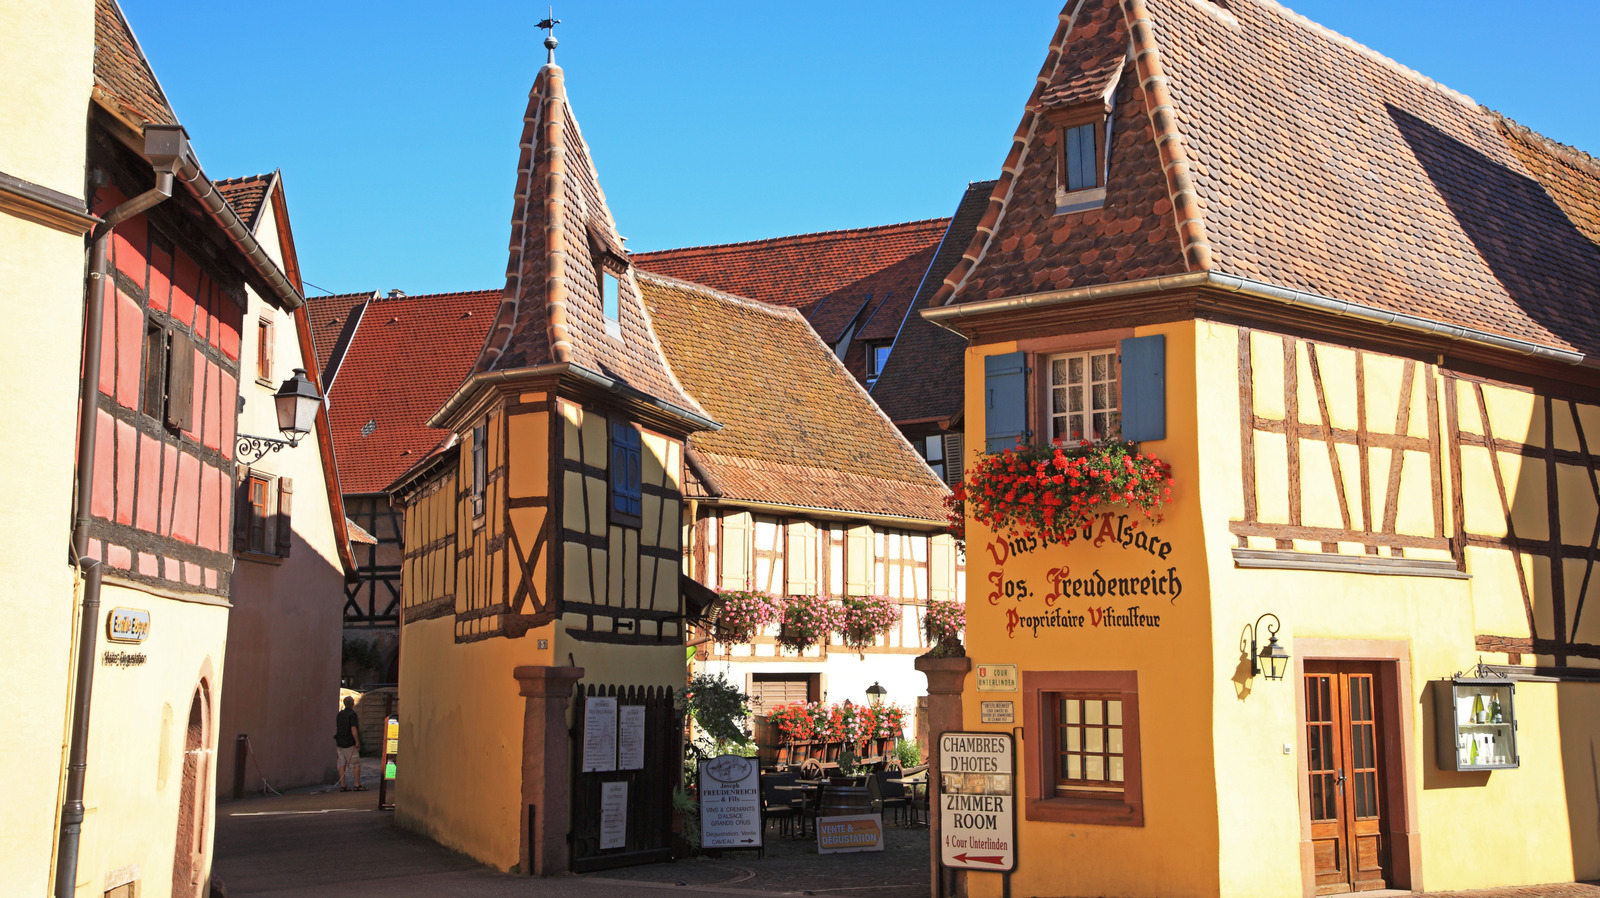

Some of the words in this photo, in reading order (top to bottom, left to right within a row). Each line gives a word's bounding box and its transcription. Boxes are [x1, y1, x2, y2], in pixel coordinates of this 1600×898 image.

[986, 533, 1037, 567] Vins
[1081, 512, 1172, 560] d'Alsace
[988, 568, 1034, 606] Jos.
[1045, 565, 1183, 606] Freudenreich
[1006, 607, 1085, 639] Propriétaire
[1088, 606, 1160, 628] Viticulteur
[994, 669, 1008, 677] COUR
[943, 737, 1005, 753] CHAMBRES
[951, 756, 998, 772] D'HOTES
[703, 788, 757, 796] FREUDENREICH
[947, 795, 1004, 812] ZIMMER
[821, 824, 846, 834] VENTE
[847, 823, 854, 832] &
[953, 813, 998, 830] ROOM
[822, 834, 877, 844] DÉGUSTATION
[945, 834, 950, 847] 4
[951, 835, 967, 849] Cour
[969, 836, 1008, 851] Unterlinden
